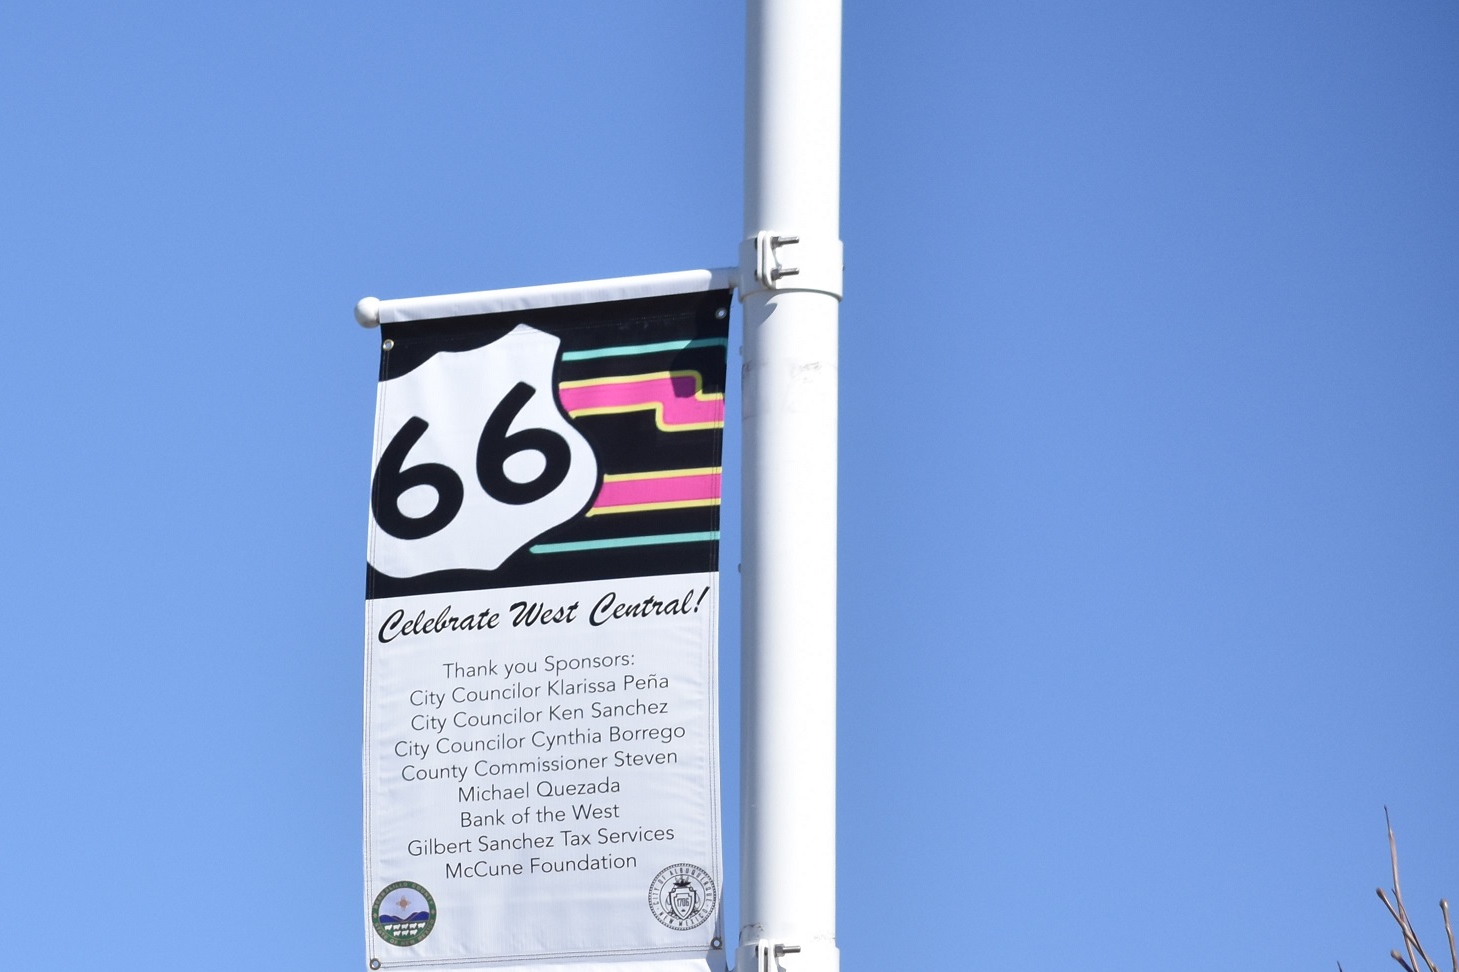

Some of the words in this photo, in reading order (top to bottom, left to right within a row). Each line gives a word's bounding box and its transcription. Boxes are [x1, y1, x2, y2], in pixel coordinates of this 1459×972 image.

[371, 380, 571, 540] 66
[377, 604, 500, 644] Celebrate
[509, 600, 580, 628] West
[588, 585, 711, 627] Central!
[442, 659, 498, 679] Thank
[503, 659, 538, 685] you
[543, 653, 636, 677] Sponsors:
[409, 689, 446, 710] City
[451, 681, 541, 704] Councilor
[547, 678, 616, 697] Klarissa
[623, 673, 669, 691] Peña
[411, 714, 447, 734] City
[453, 706, 543, 728] Councilor
[549, 704, 584, 722] Ken
[591, 698, 668, 719] Sanchez
[394, 740, 430, 761] City
[436, 732, 526, 754] Councilor
[531, 727, 602, 752] Cynthia
[609, 725, 686, 744] Borrego
[401, 764, 468, 783] County
[474, 755, 608, 777] Commissioner
[614, 750, 678, 768] Steven
[458, 781, 529, 803] Michael
[536, 776, 620, 798] Quezada
[460, 808, 506, 828] Bank
[511, 806, 531, 825] of
[535, 805, 566, 823] the
[571, 803, 620, 821] West
[407, 837, 473, 857] Gilbert
[478, 832, 555, 853] Sanchez
[559, 830, 592, 847] Tax
[597, 825, 675, 845] Services
[445, 860, 524, 879] McCune
[530, 853, 637, 874] Foundation
